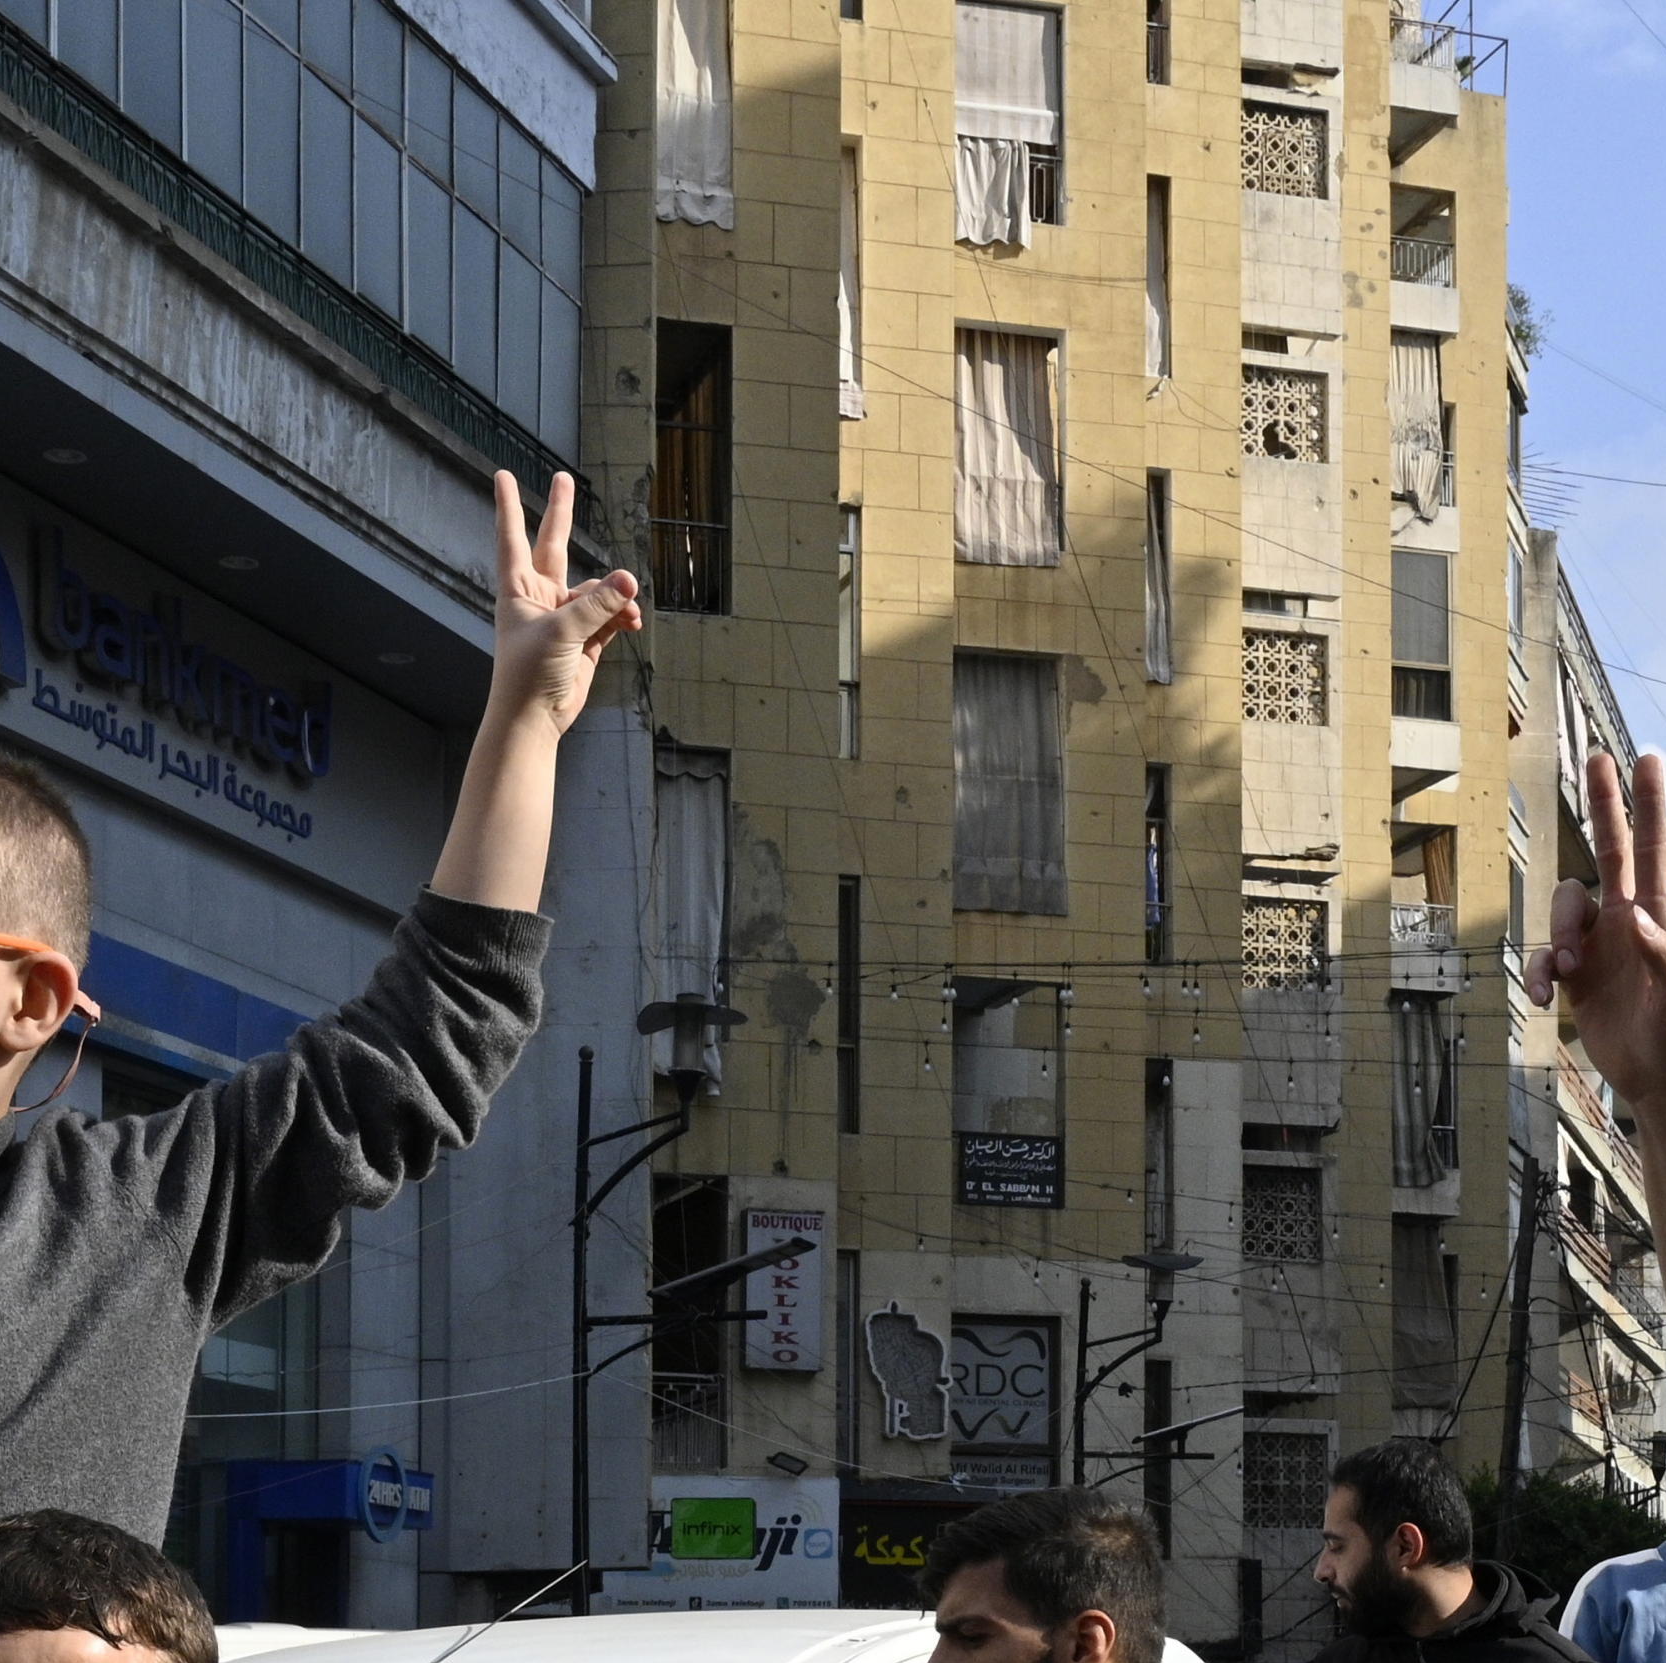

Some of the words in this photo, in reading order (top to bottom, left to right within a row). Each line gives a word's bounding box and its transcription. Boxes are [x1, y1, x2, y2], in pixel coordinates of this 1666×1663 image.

[45, 524, 334, 778] bankmed
[158, 743, 220, 798] البحر
[223, 762, 312, 842] مجموعة
[751, 1214, 823, 1233] BOUTIQUE
[771, 1237, 800, 1363] OKLIKO
[368, 1479, 403, 1508] 24HRS
[407, 1485, 431, 1512] ATM
[971, 1462, 1003, 1475] Walid
[1005, 1463, 1018, 1475] Al
